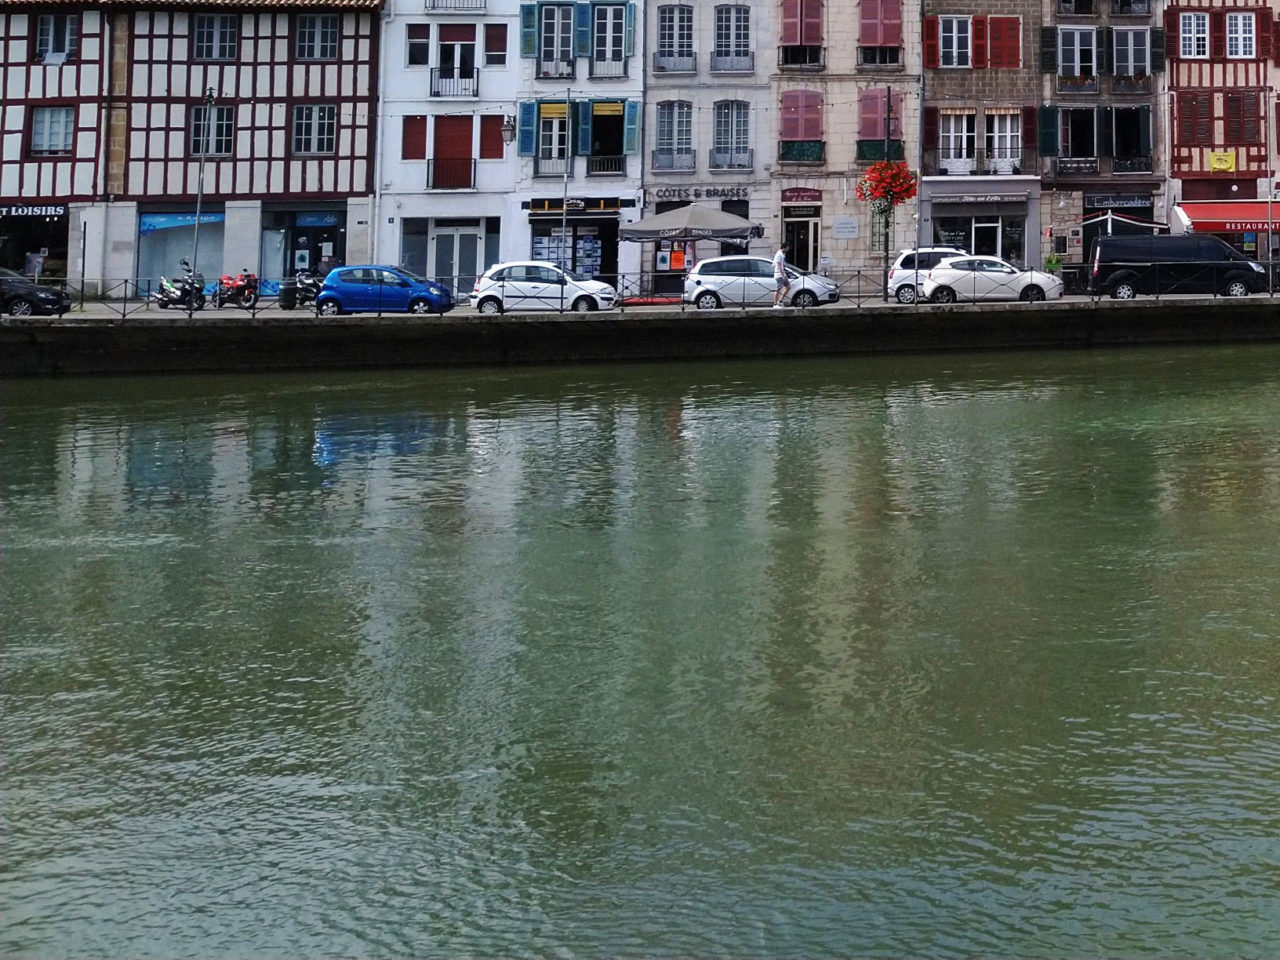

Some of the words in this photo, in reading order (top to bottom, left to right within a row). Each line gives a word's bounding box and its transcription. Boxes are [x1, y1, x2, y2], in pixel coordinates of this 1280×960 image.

[694, 188, 702, 199] &
[706, 187, 749, 199] BRAISES
[11, 206, 65, 216] LOISIRS
[1225, 222, 1280, 230] RESTAURANT
